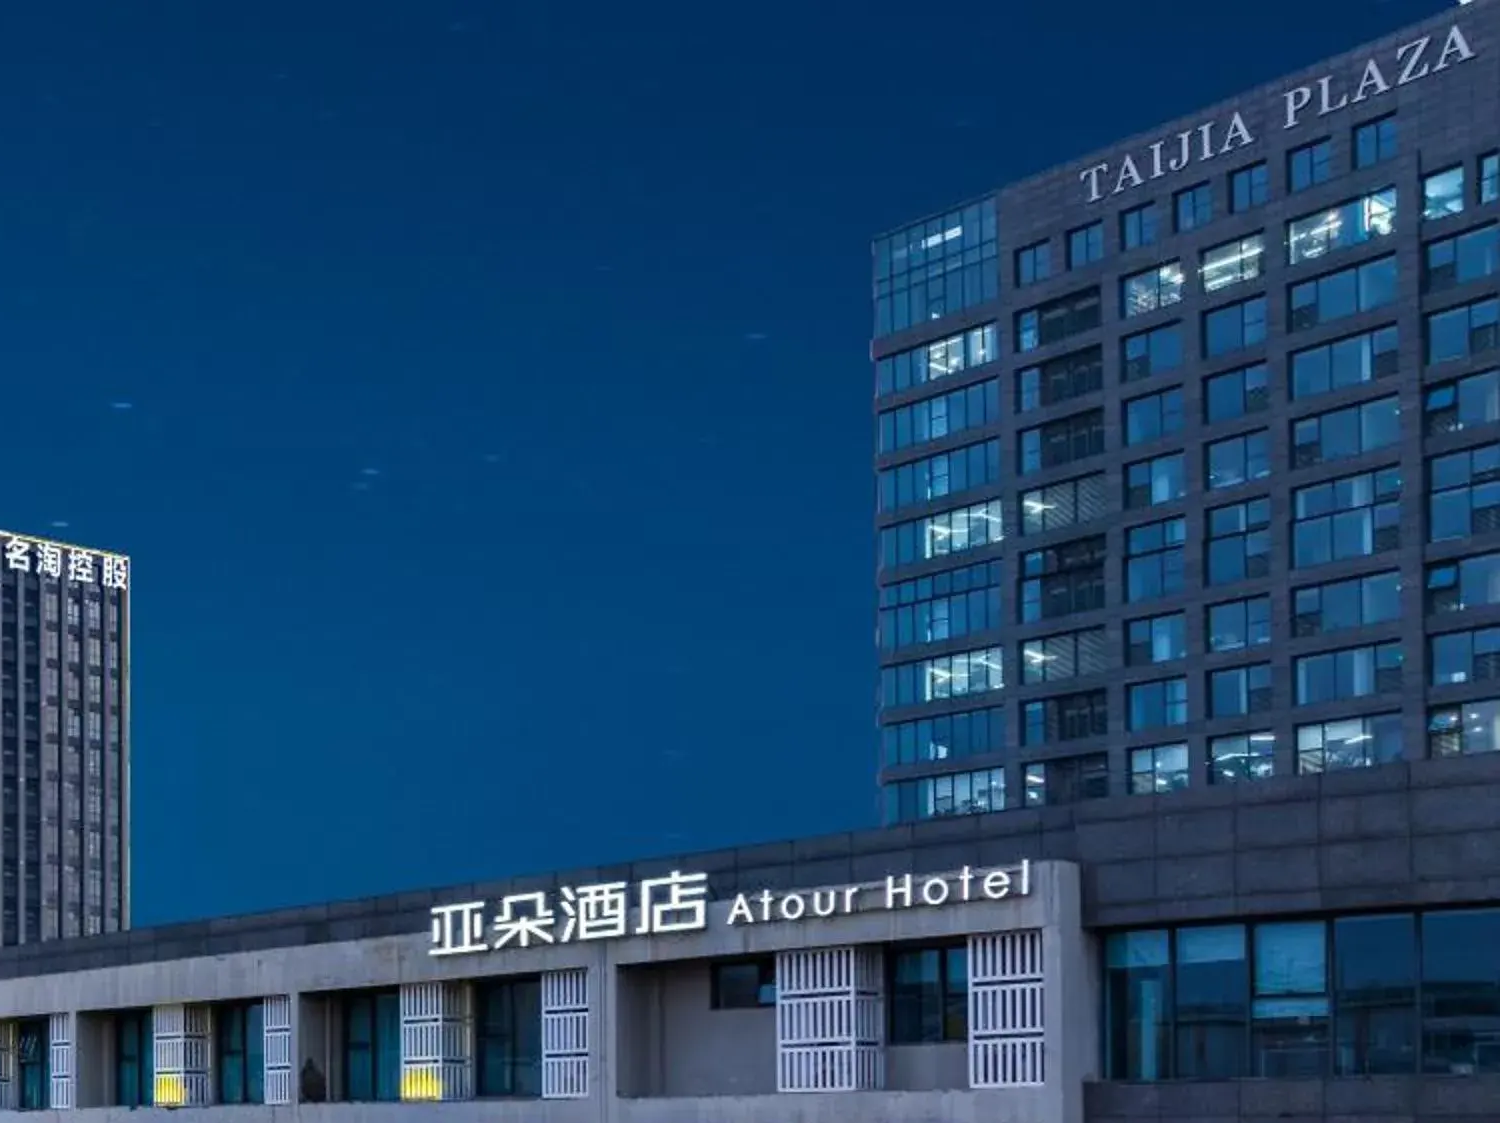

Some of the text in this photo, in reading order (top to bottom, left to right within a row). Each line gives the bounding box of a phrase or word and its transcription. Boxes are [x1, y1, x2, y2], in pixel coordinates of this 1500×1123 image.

[1080, 25, 1476, 203] TAIJIA PLAZA
[428, 870, 707, 957] 亚朵酒店
[726, 859, 1030, 925] Atour Hotel
